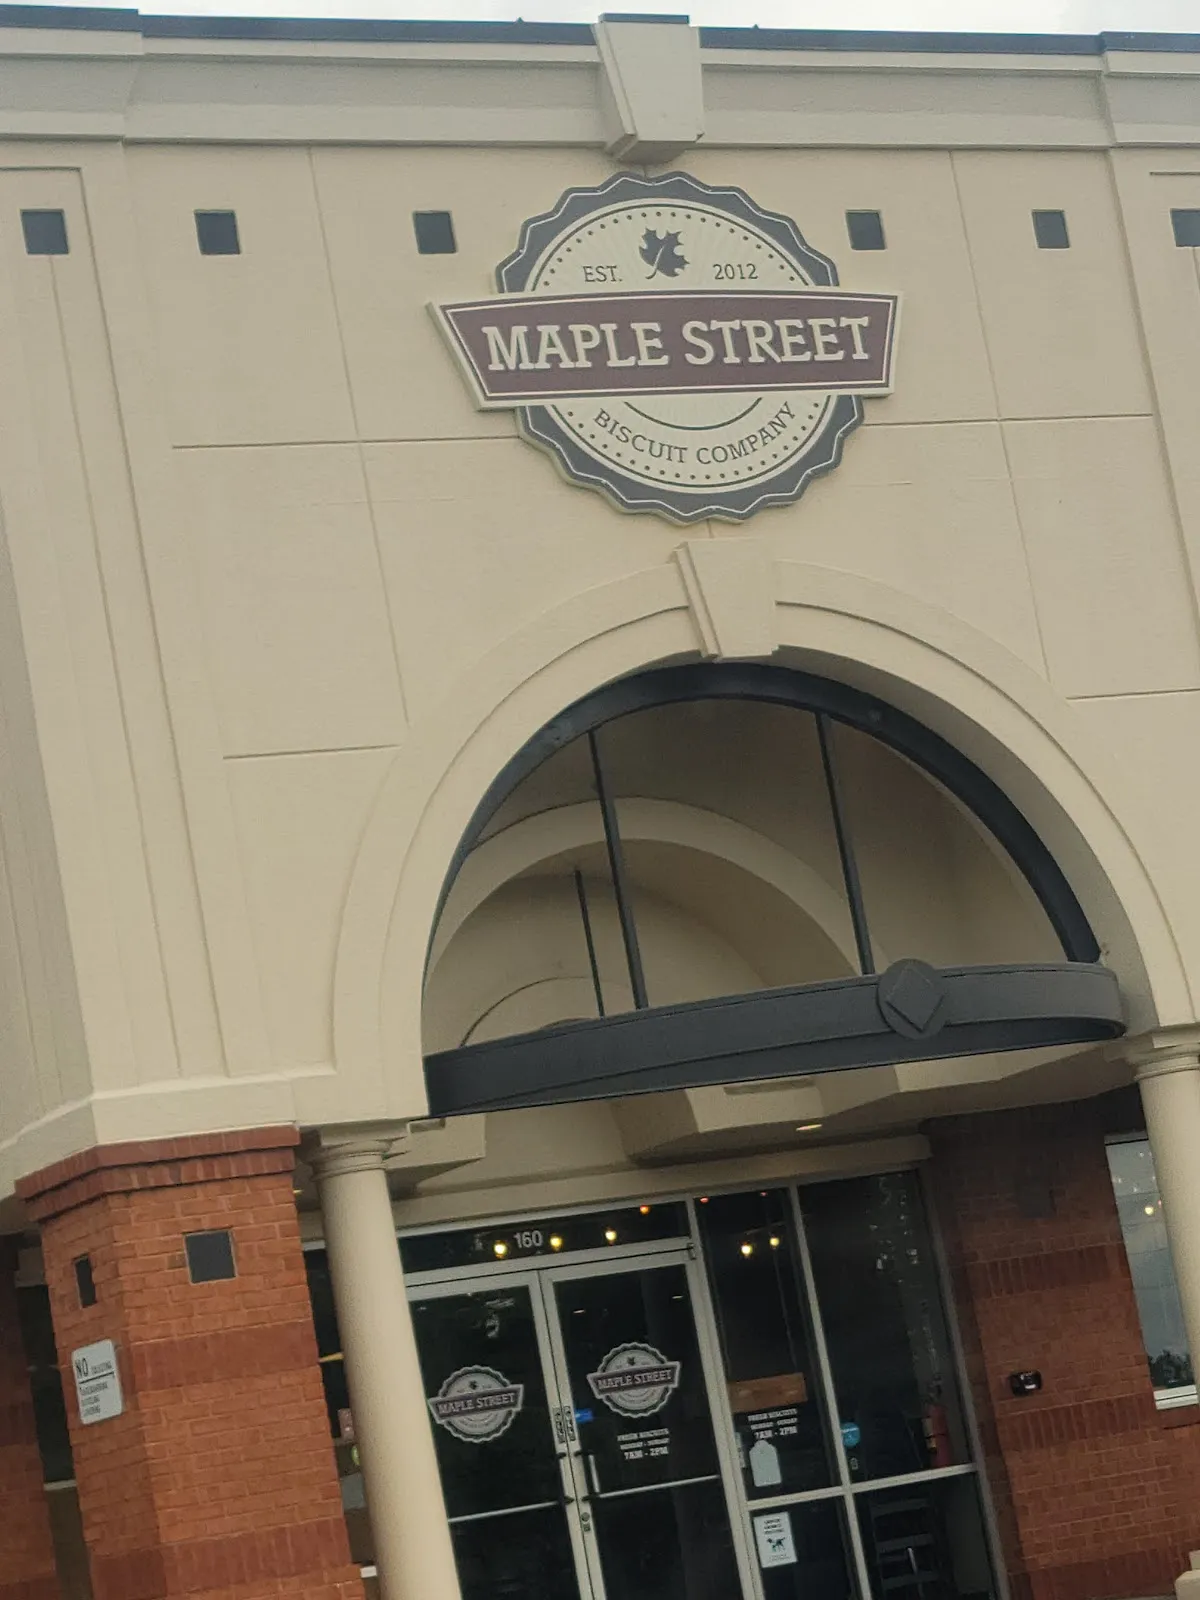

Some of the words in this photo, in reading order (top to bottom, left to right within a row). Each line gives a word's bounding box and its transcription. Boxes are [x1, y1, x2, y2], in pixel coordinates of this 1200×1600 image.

[583, 264, 623, 283] EST.
[712, 262, 759, 281] 2012
[482, 320, 669, 371] MAPLE
[681, 316, 869, 366] STREET
[593, 408, 688, 463] BISCUIT
[696, 401, 795, 464] COMPANY
[513, 1230, 543, 1249] 160
[597, 1374, 633, 1390] MAPLE
[634, 1369, 673, 1385] STREET
[437, 1399, 475, 1414] MAPLE
[476, 1392, 516, 1409] STREET
